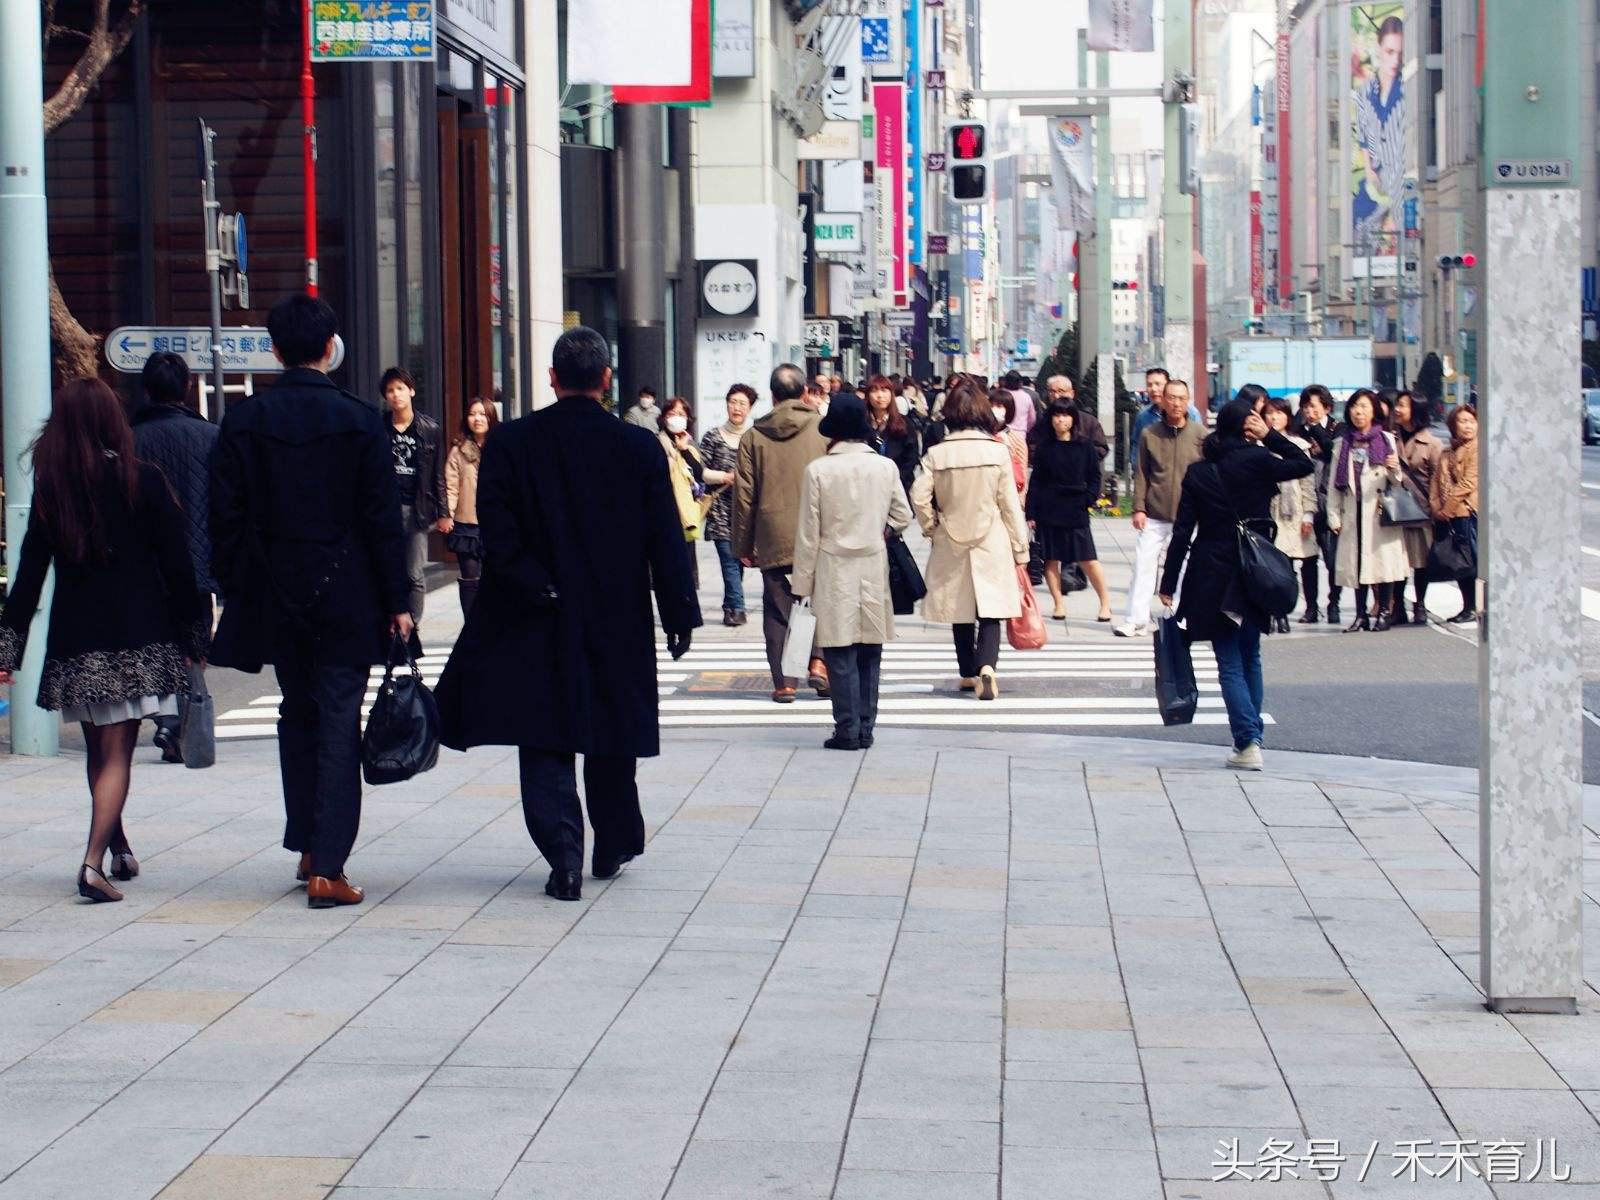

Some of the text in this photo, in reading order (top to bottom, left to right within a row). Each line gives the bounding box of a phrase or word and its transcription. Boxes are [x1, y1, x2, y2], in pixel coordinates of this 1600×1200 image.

[1516, 165, 1527, 177] U
[1529, 165, 1561, 177] 0194
[836, 224, 854, 240] LIFE
[222, 354, 249, 364] Office
